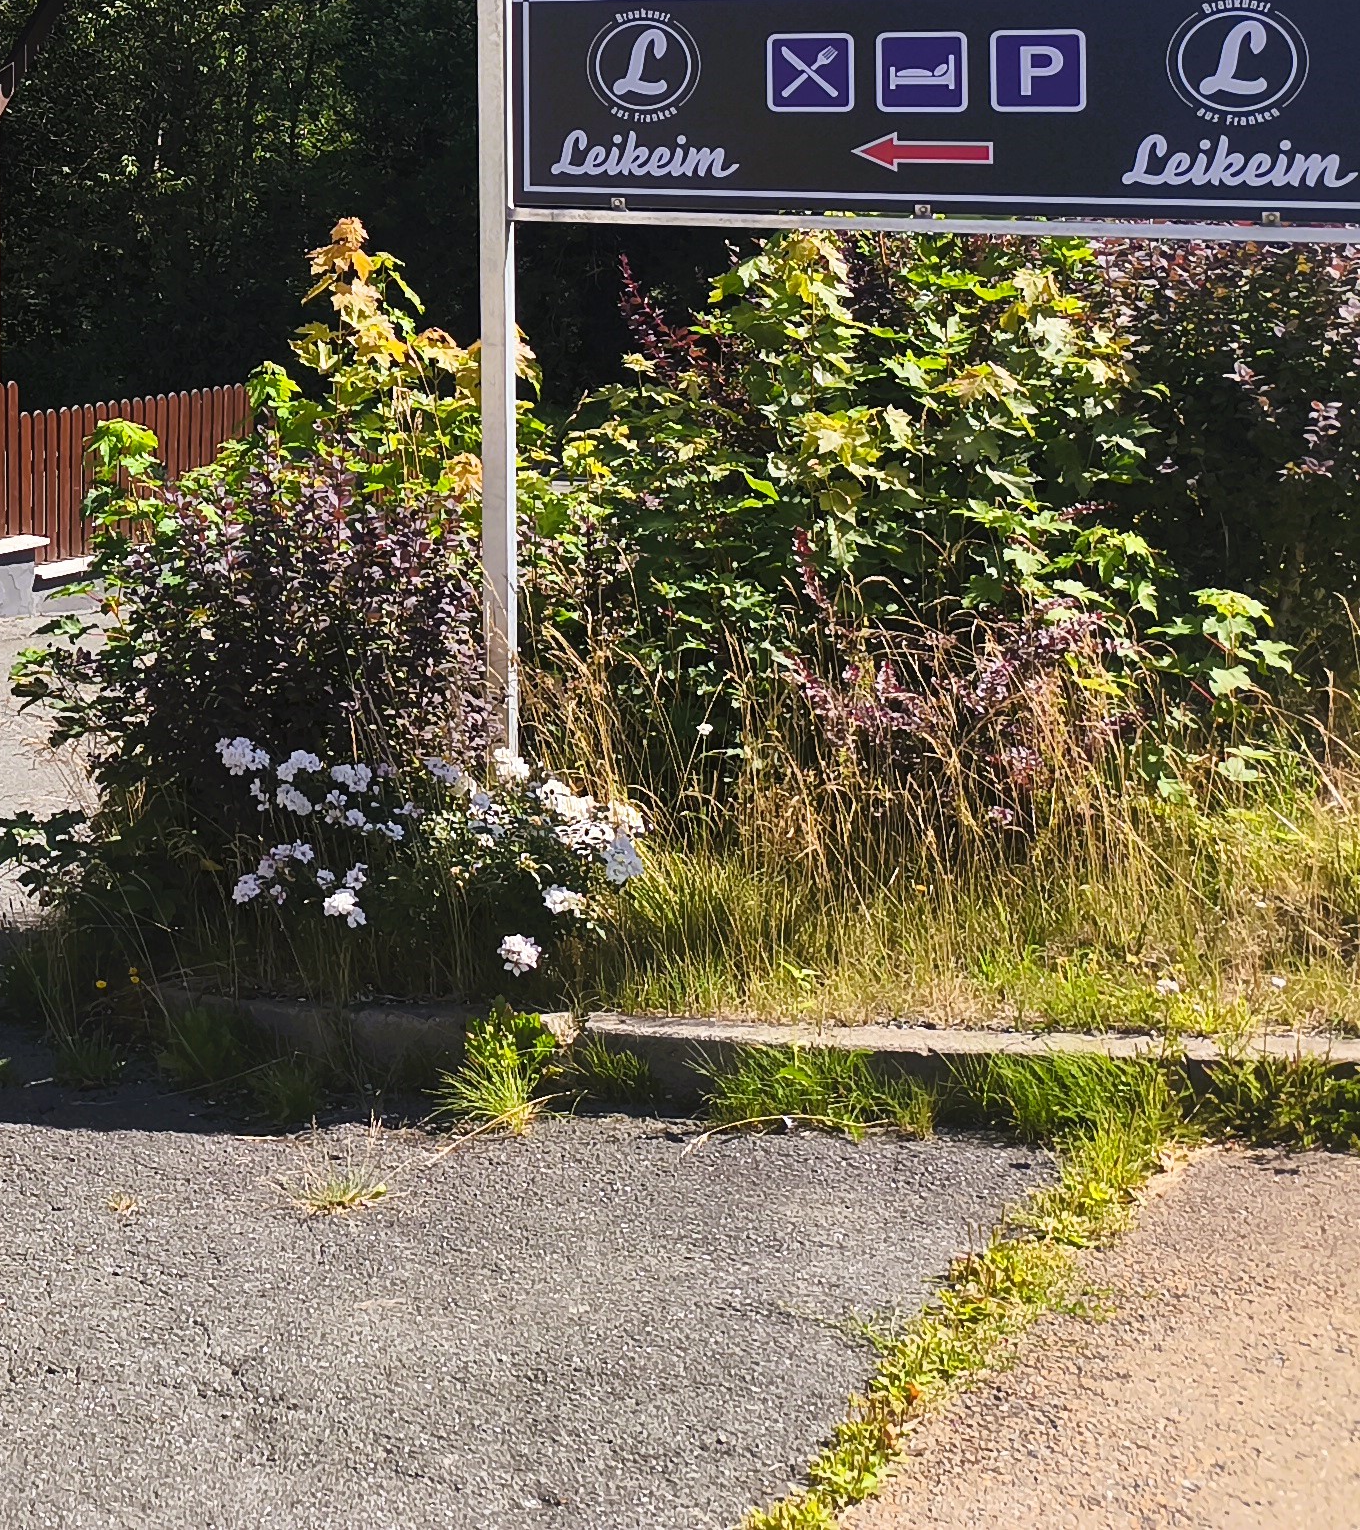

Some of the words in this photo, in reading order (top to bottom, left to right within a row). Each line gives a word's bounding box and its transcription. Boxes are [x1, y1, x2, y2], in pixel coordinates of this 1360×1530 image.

[615, 8, 671, 23] Braukunst
[613, 28, 668, 95] L
[1019, 45, 1064, 97] P
[1199, 20, 1268, 95] L
[611, 106, 630, 120] aus
[634, 105, 678, 122] Franken
[1196, 107, 1220, 123] aus
[1226, 107, 1281, 126] Franken
[550, 129, 740, 178] Leikeim
[1121, 133, 1359, 188] Leikeim
